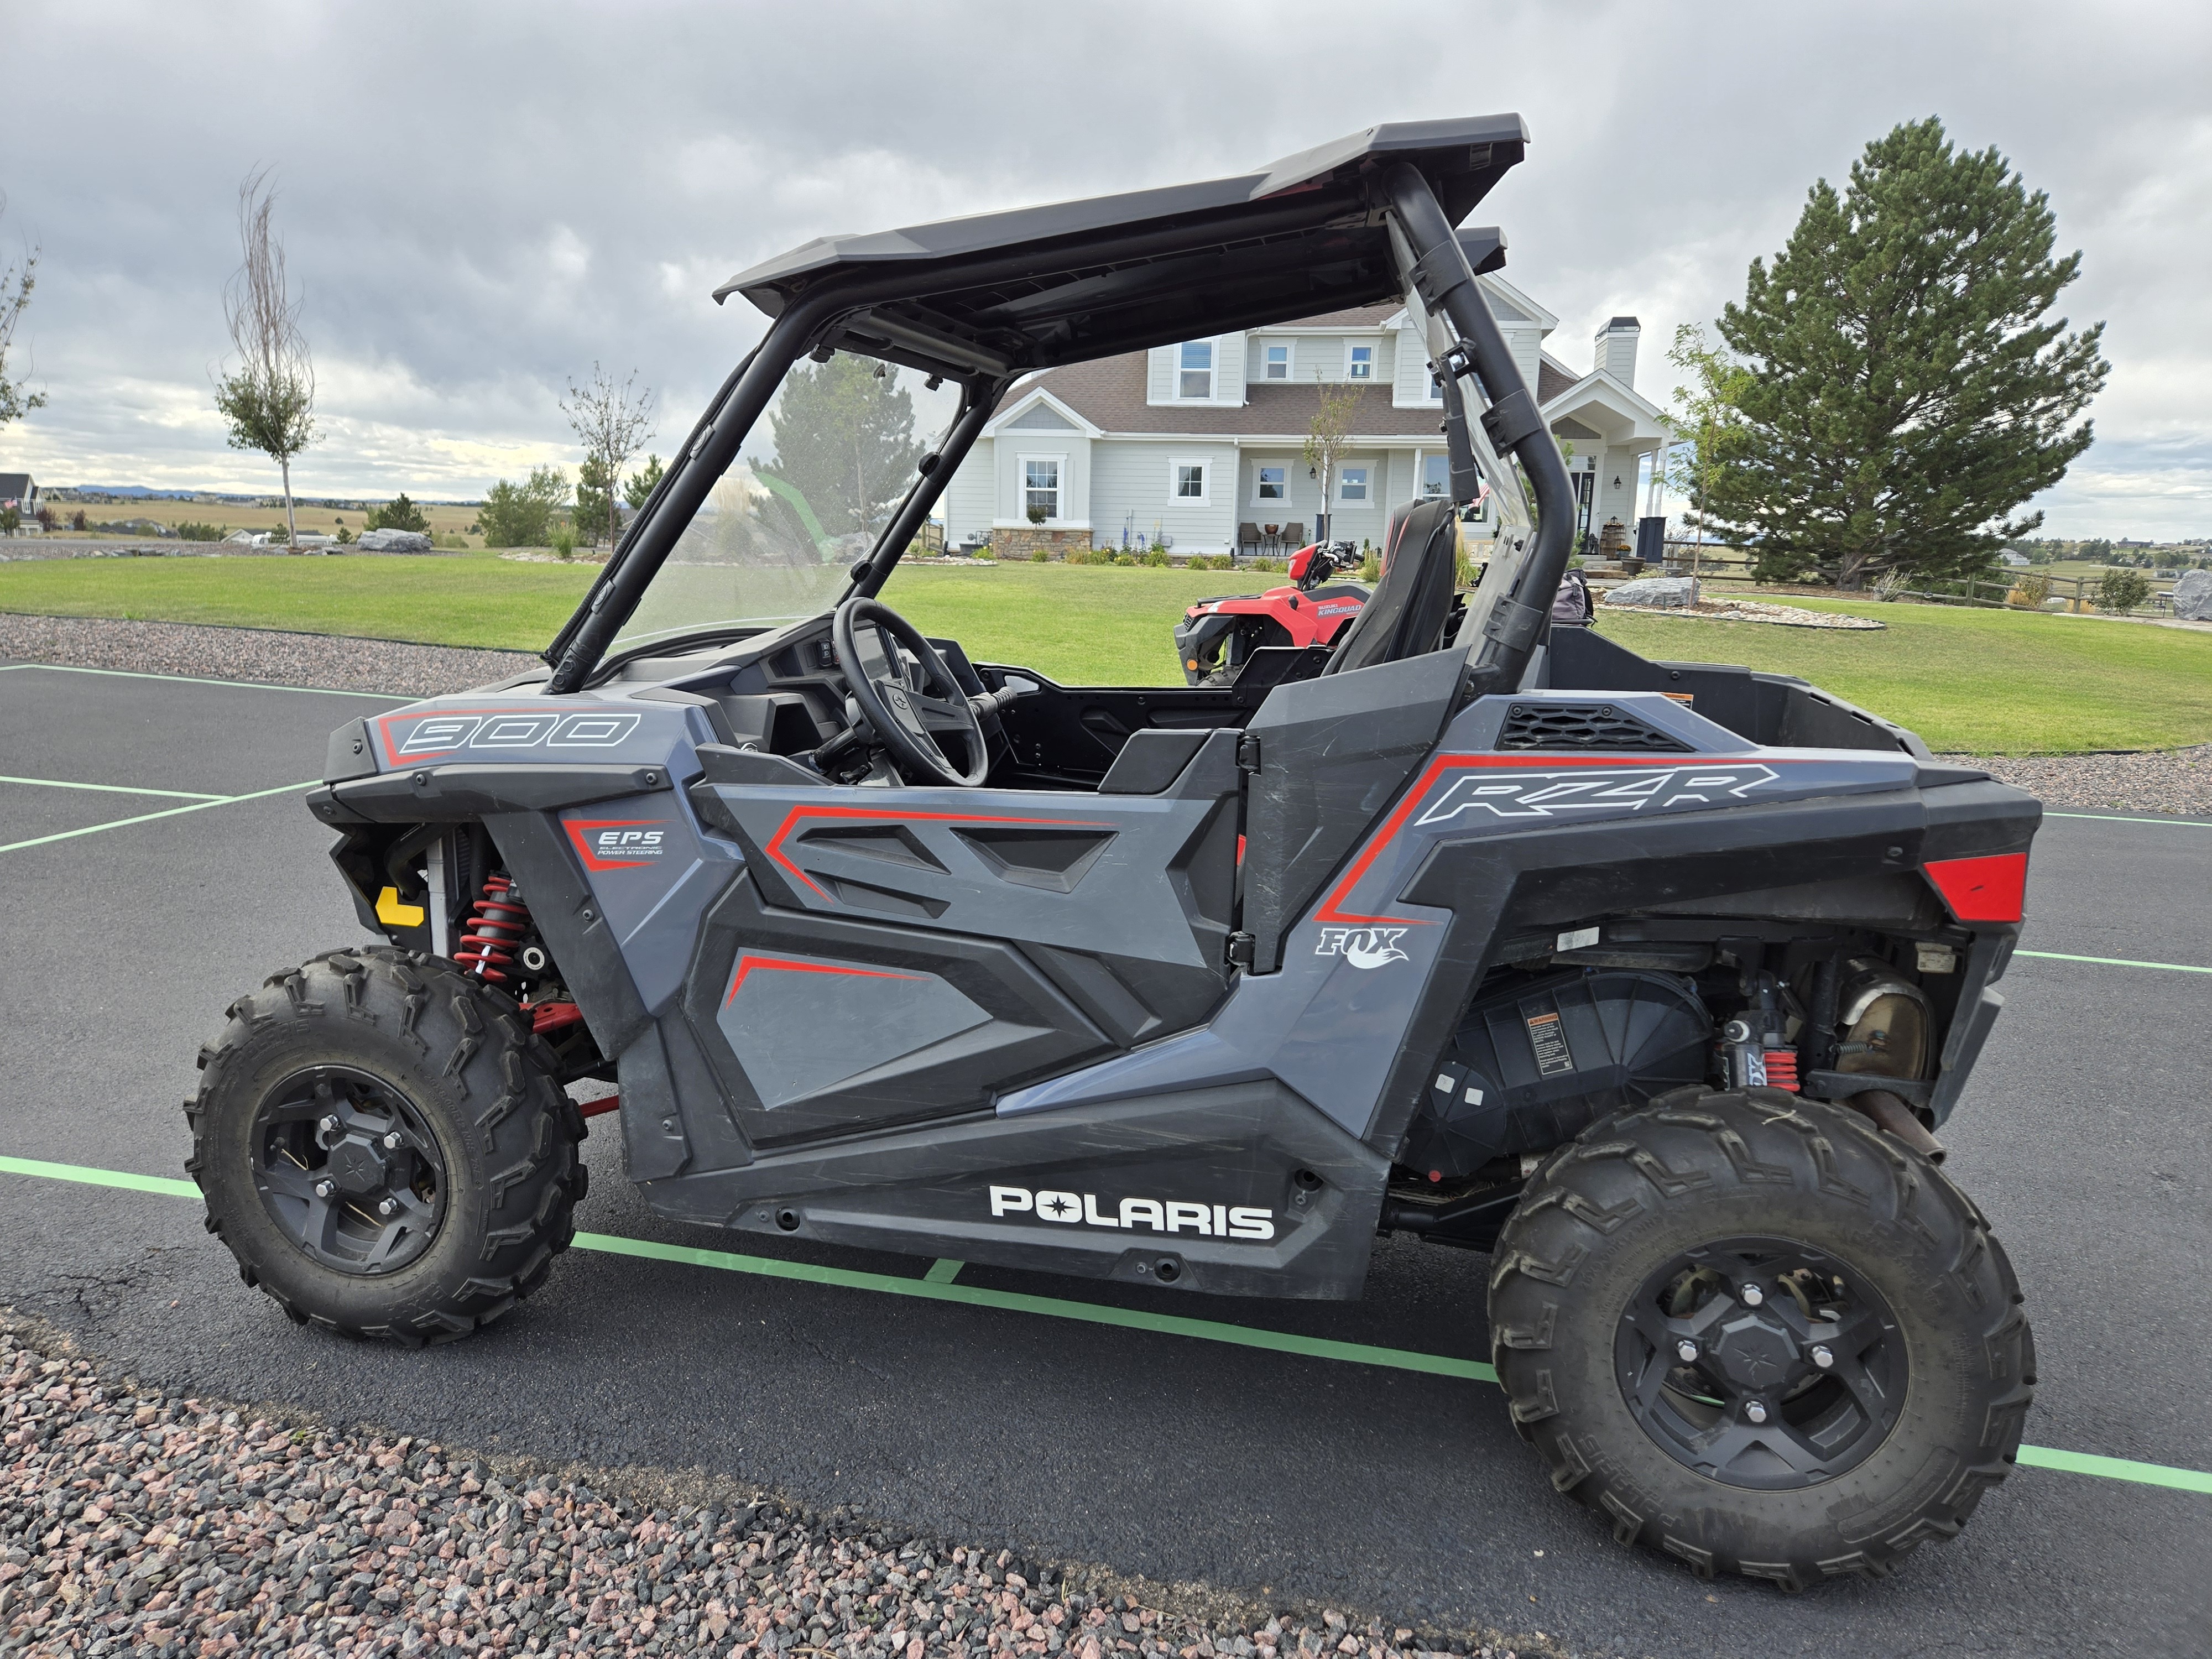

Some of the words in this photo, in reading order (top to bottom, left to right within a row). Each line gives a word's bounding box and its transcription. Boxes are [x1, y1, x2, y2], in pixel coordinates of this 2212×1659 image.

[1318, 604, 1361, 616] KINGQUAD
[399, 714, 641, 754] 900
[1414, 764, 1780, 826] RZR
[598, 831, 664, 844] EPS
[1315, 927, 1408, 957] FOX
[989, 1185, 1275, 1239] POLARIS
